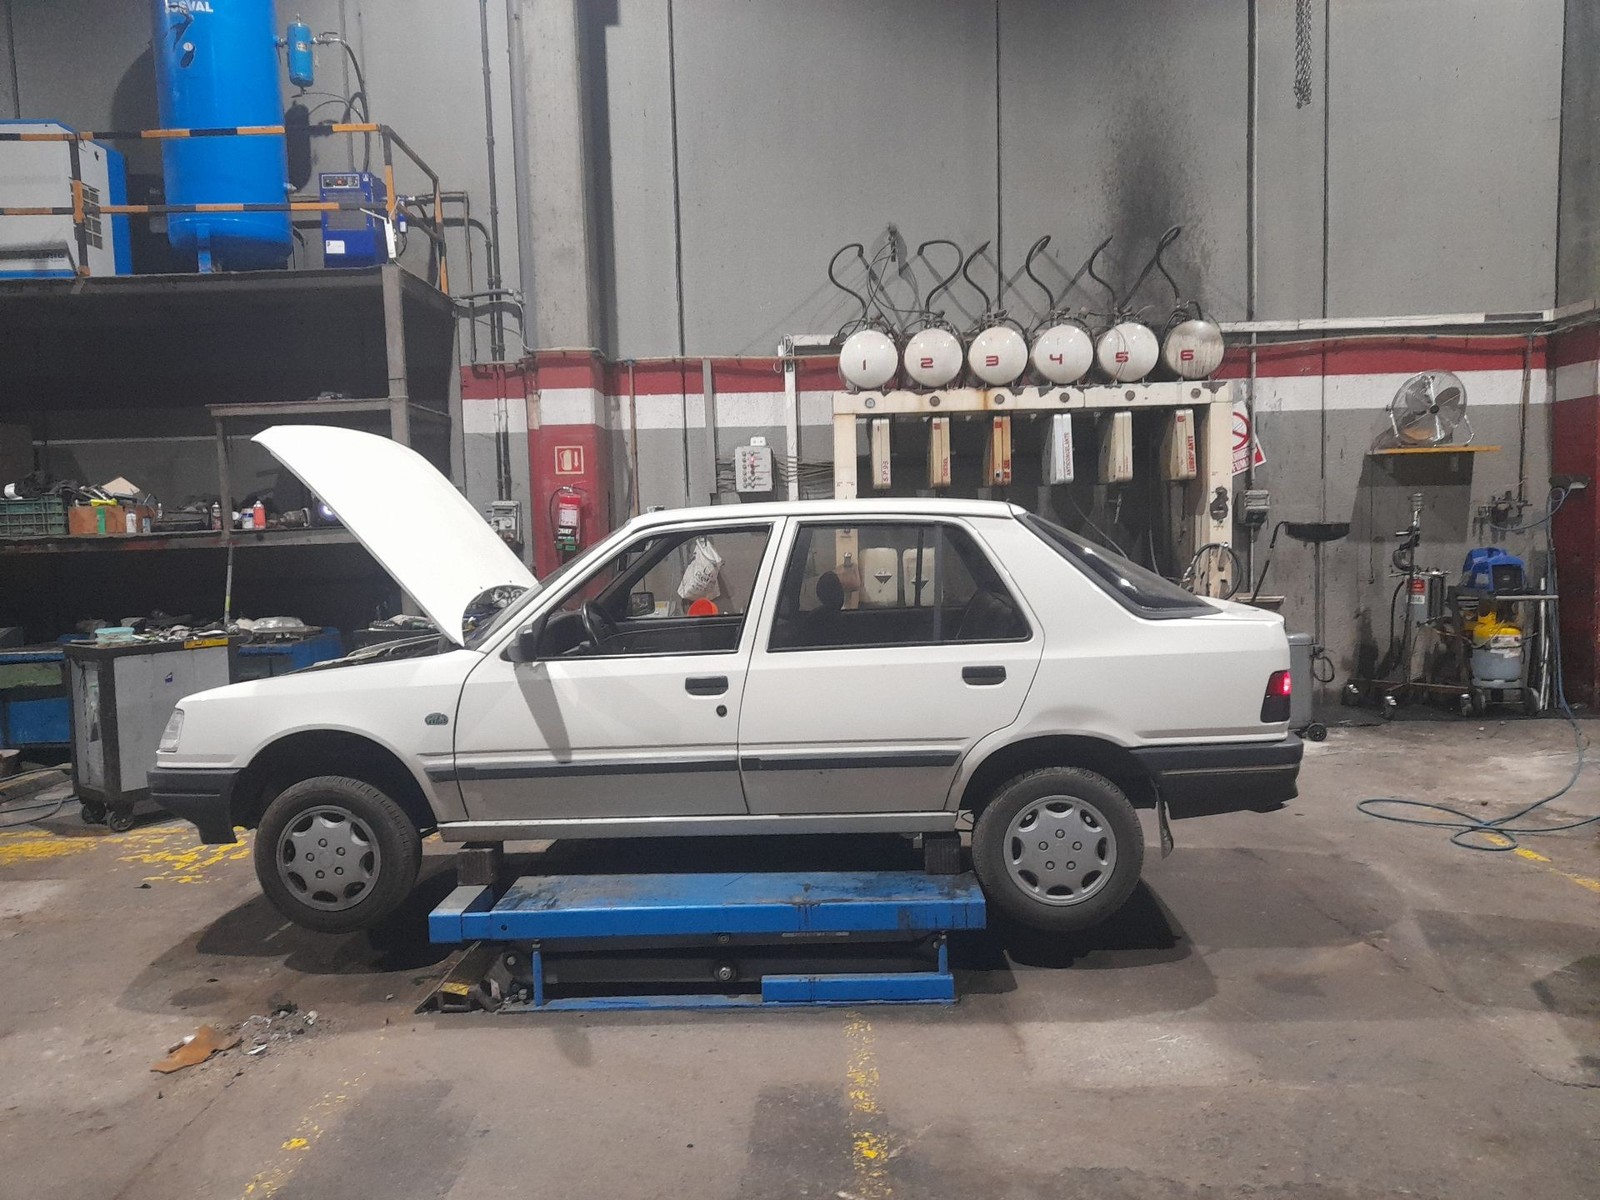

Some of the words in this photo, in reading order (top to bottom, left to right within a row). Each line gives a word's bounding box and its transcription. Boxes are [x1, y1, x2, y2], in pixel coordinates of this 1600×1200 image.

[985, 355, 999, 367] 3
[1049, 353, 1063, 365] 4
[1115, 351, 1129, 363] 5
[1180, 349, 1194, 361] 6
[862, 359, 868, 371] 1
[920, 357, 934, 369] 2
